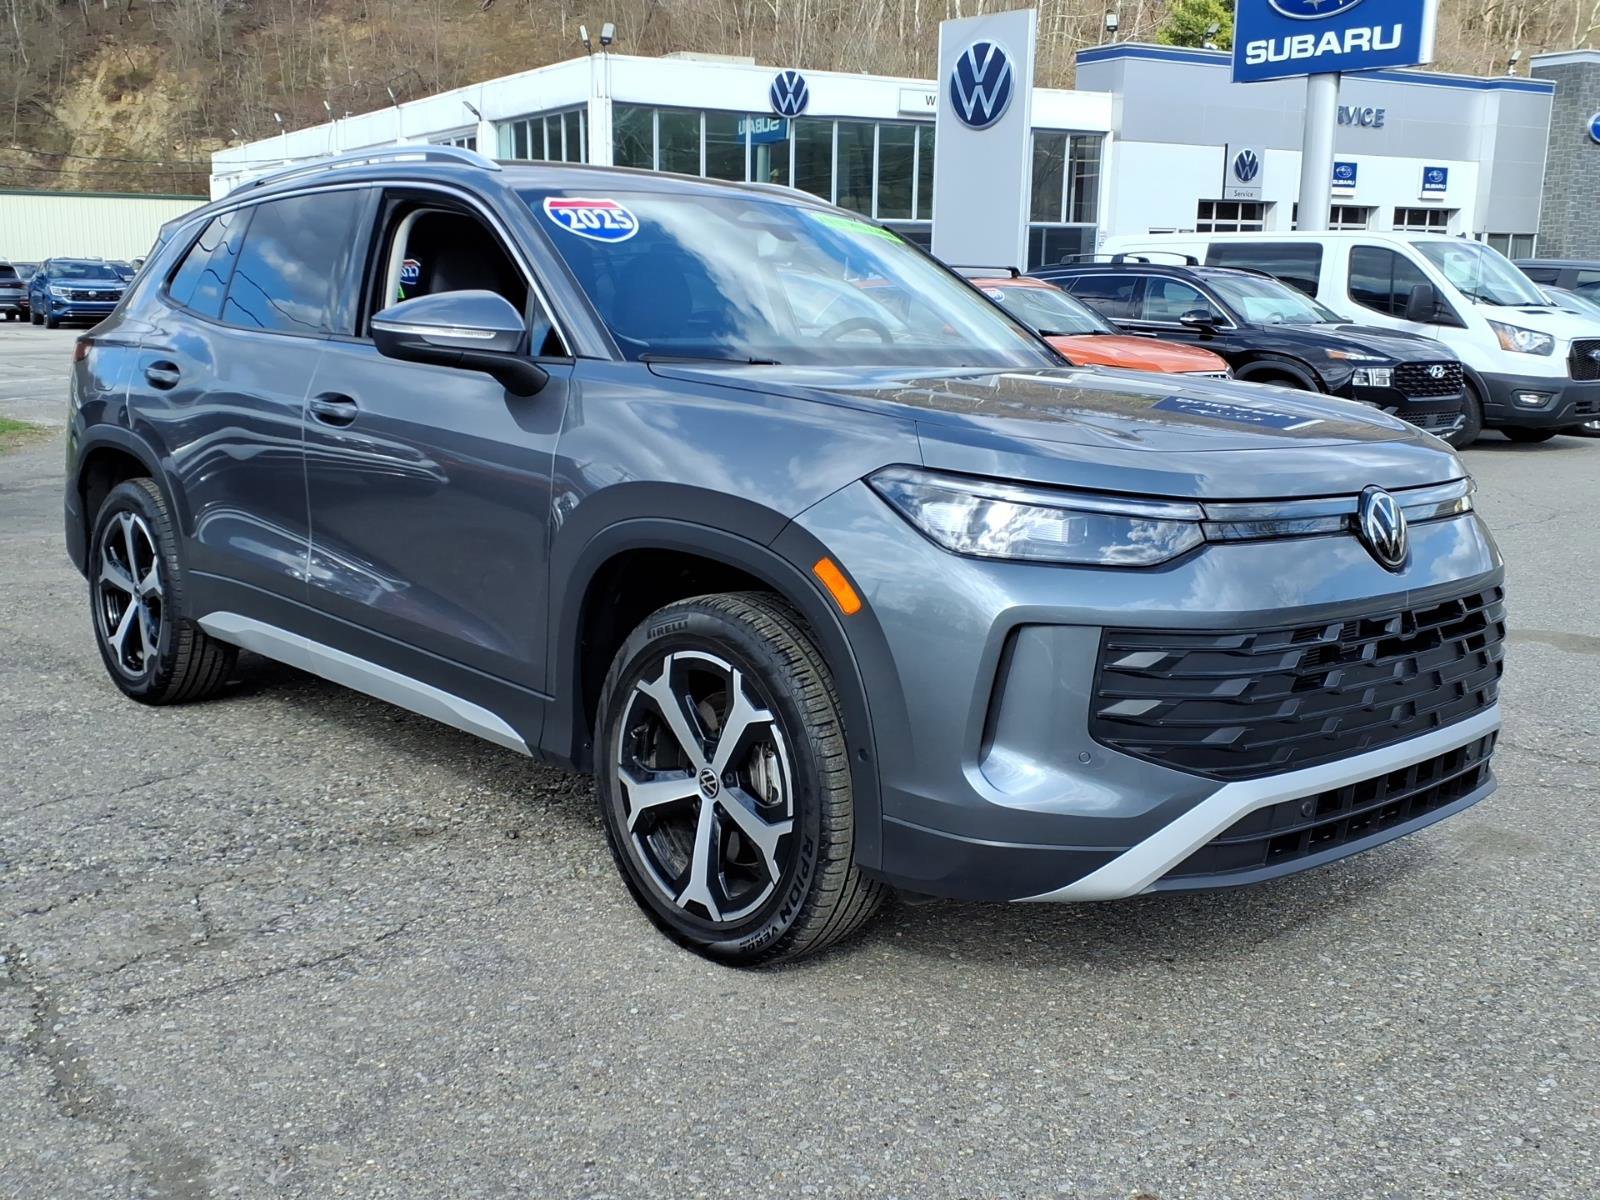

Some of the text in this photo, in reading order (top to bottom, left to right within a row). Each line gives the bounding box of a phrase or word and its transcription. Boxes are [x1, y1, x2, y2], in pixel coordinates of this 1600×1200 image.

[1245, 23, 1402, 65] SUBARU
[1337, 105, 1386, 128] RVICE
[558, 208, 634, 229] 2025
[647, 620, 689, 640] PIRELLI
